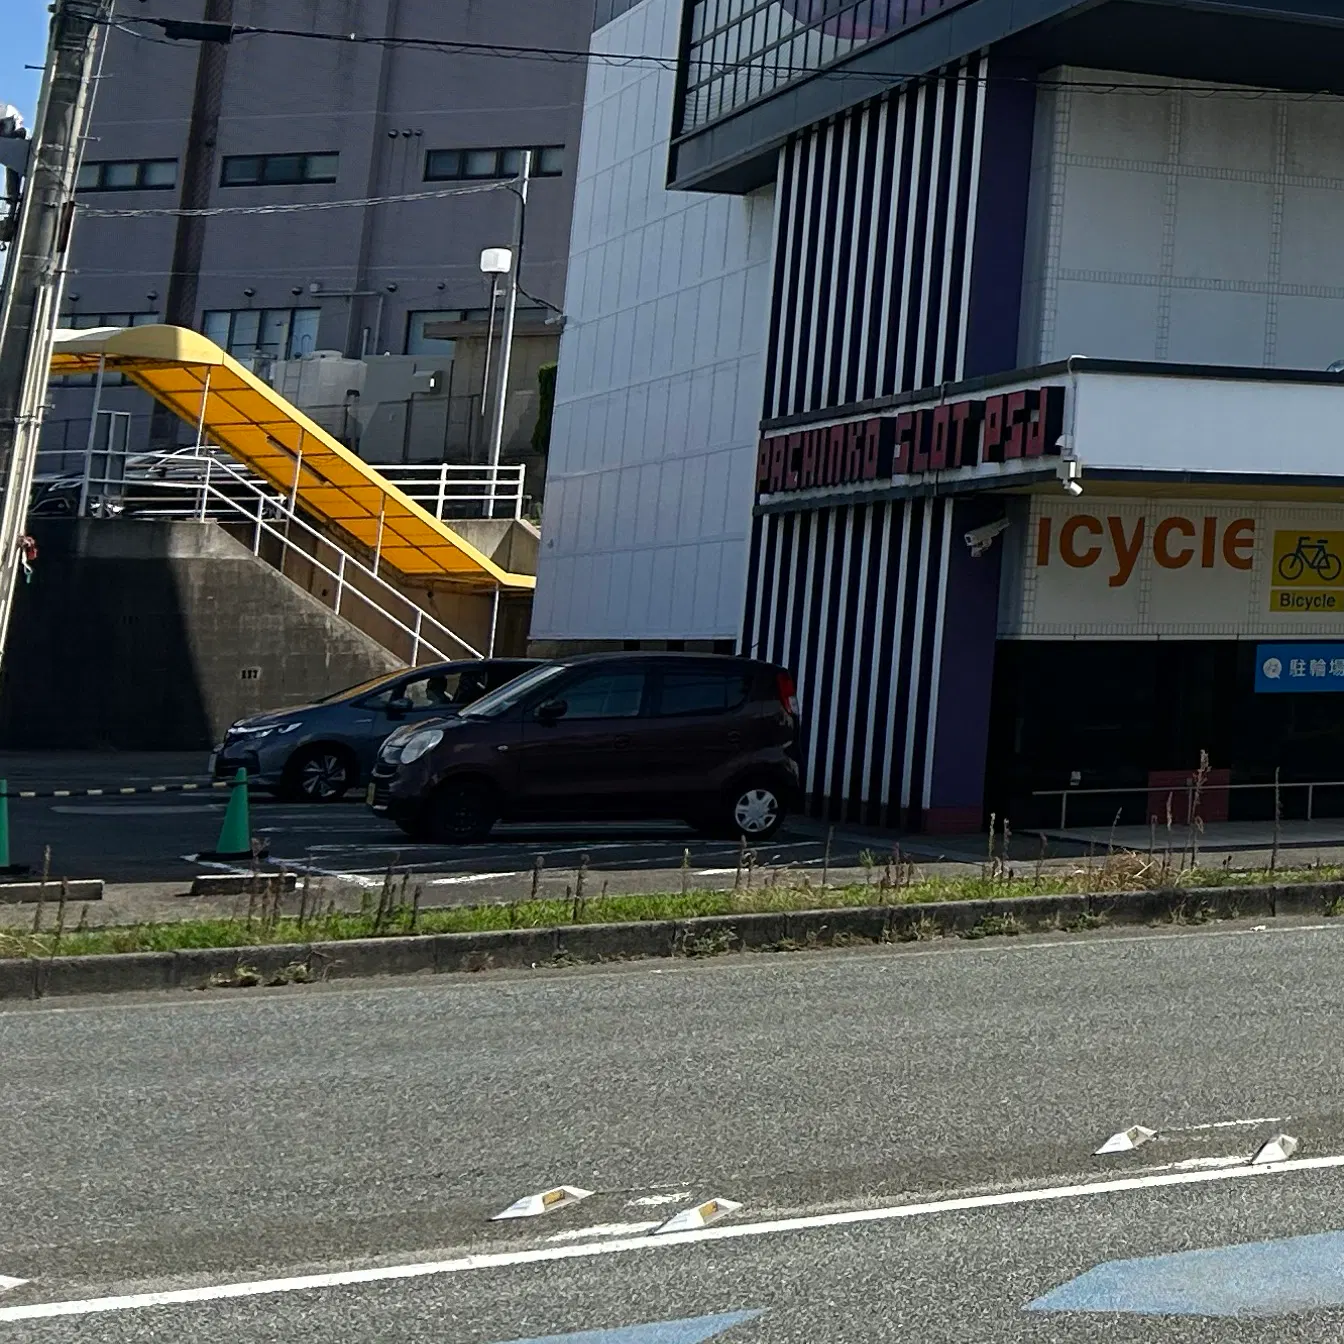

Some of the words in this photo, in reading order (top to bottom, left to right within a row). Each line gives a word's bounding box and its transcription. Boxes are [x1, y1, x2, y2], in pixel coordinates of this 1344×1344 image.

[756, 416, 897, 493] PACHINKO
[894, 400, 986, 473] SLOT
[982, 386, 1065, 463] PSJ
[1279, 593, 1336, 612] Bicycle
